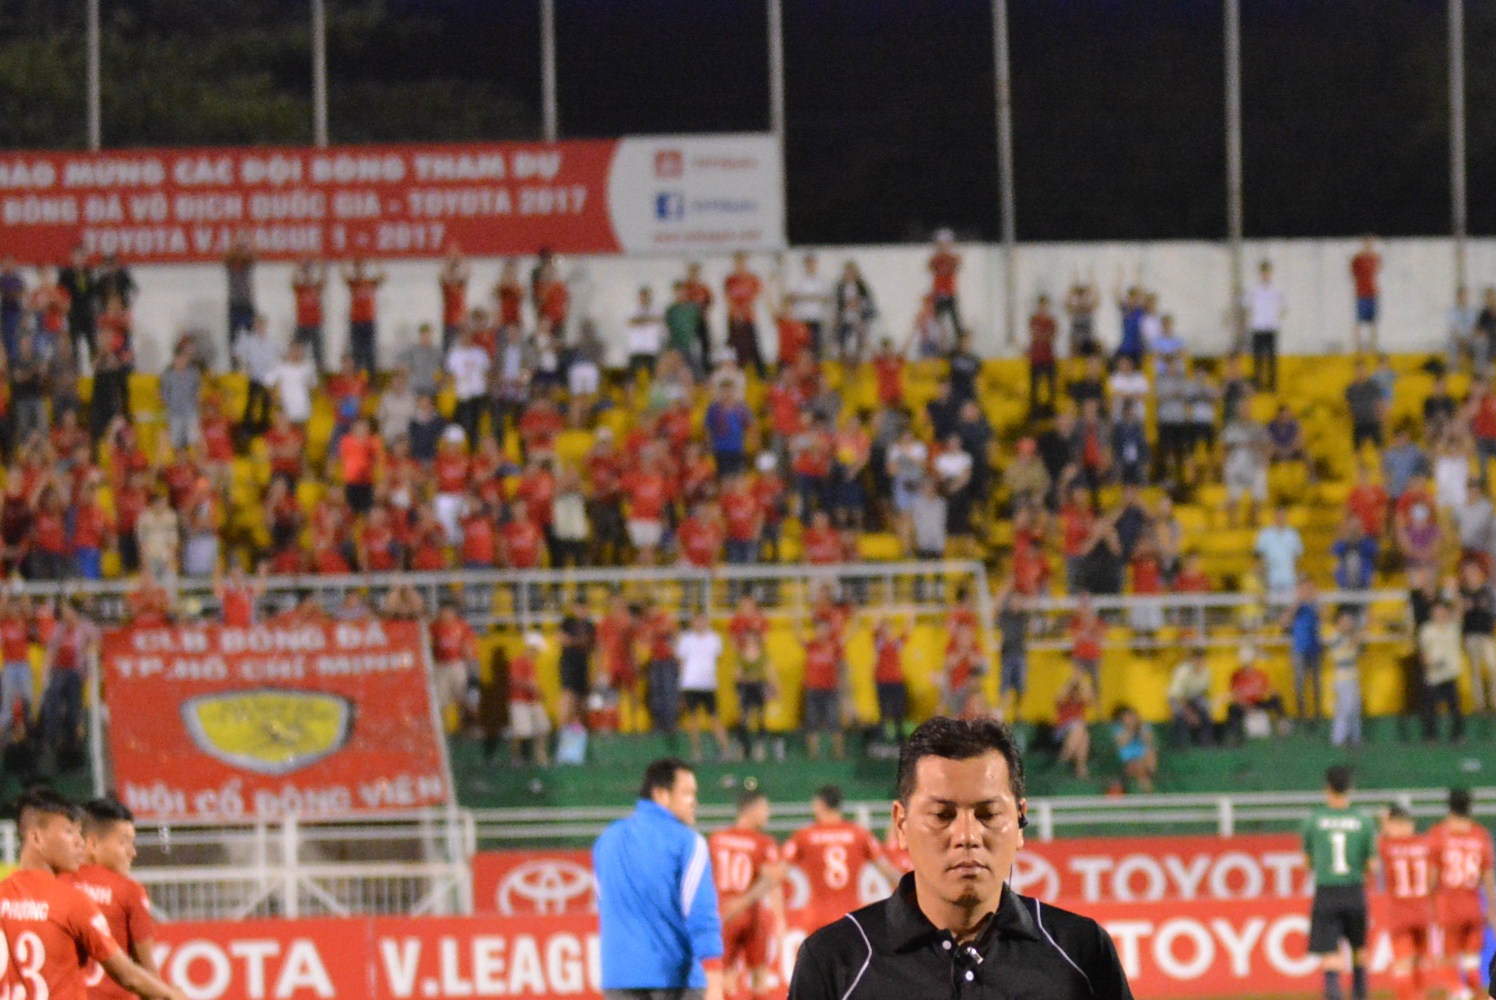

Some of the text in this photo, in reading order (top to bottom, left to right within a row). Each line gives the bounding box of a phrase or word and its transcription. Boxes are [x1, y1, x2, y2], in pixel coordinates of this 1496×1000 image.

[716, 849, 753, 892] 10
[823, 845, 849, 890] 8
[1330, 831, 1350, 875] 1
[1069, 851, 1316, 901] TOYOT
[1392, 856, 1428, 898] 11
[152, 939, 335, 1000] OTA
[1102, 914, 1397, 980] TOYO
